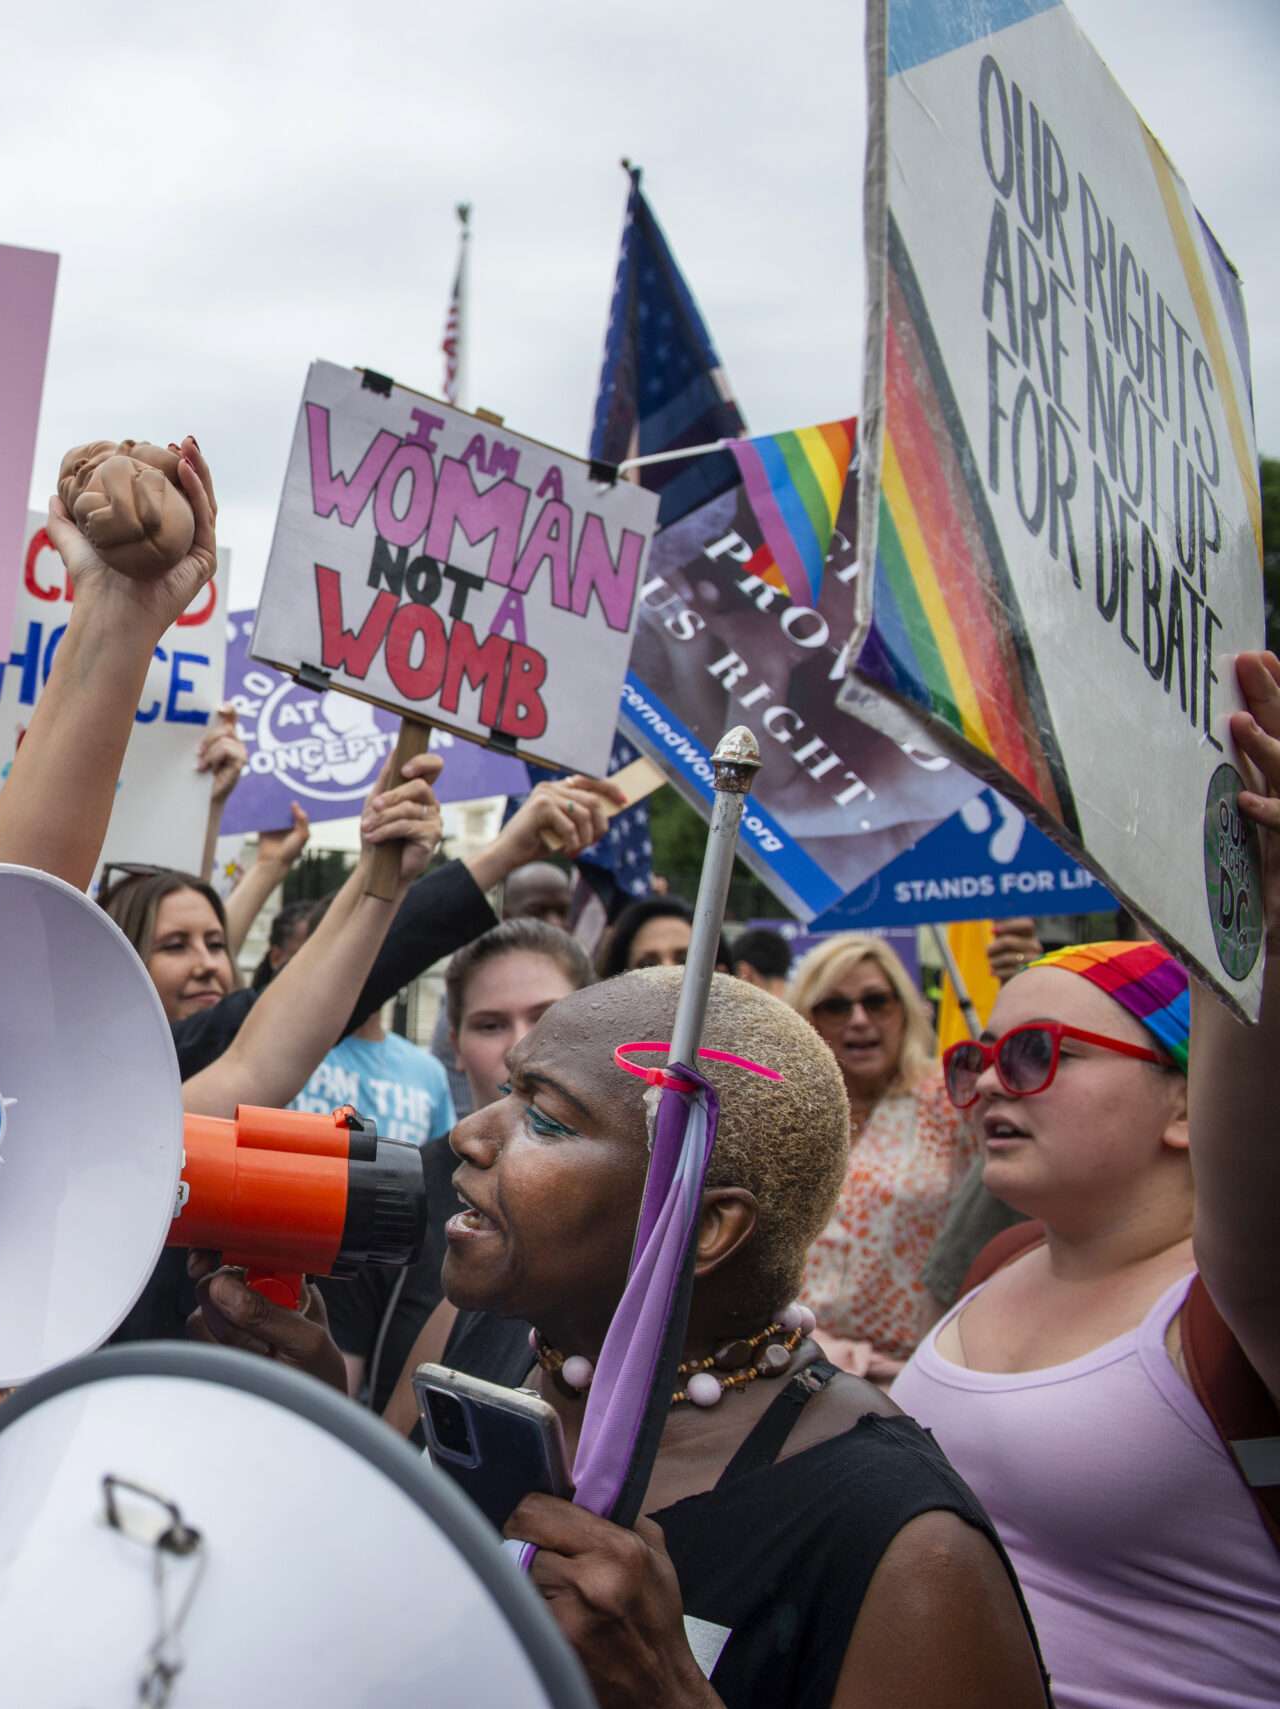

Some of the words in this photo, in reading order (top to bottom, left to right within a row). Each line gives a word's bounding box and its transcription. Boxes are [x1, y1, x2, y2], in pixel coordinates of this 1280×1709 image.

[977, 53, 1076, 291] OUR
[1077, 170, 1220, 488] RIGHTS
[407, 407, 445, 454] I
[460, 432, 520, 478] AM
[536, 465, 565, 500] A
[981, 197, 1081, 433] ARE
[1084, 312, 1166, 536] NOT
[1172, 439, 1222, 597] UP
[305, 401, 646, 634] WOMAN
[986, 328, 1083, 591] FOR
[1092, 459, 1224, 754] DEBATE
[314, 562, 548, 741] WOMB
[367, 535, 485, 623] NOT
[488, 589, 528, 645] A
[277, 699, 320, 728] AT
[893, 874, 996, 904] STANDS
[999, 869, 1055, 895] FOR
[1059, 868, 1108, 891] LIF
[368, 1078, 432, 1128] THE
